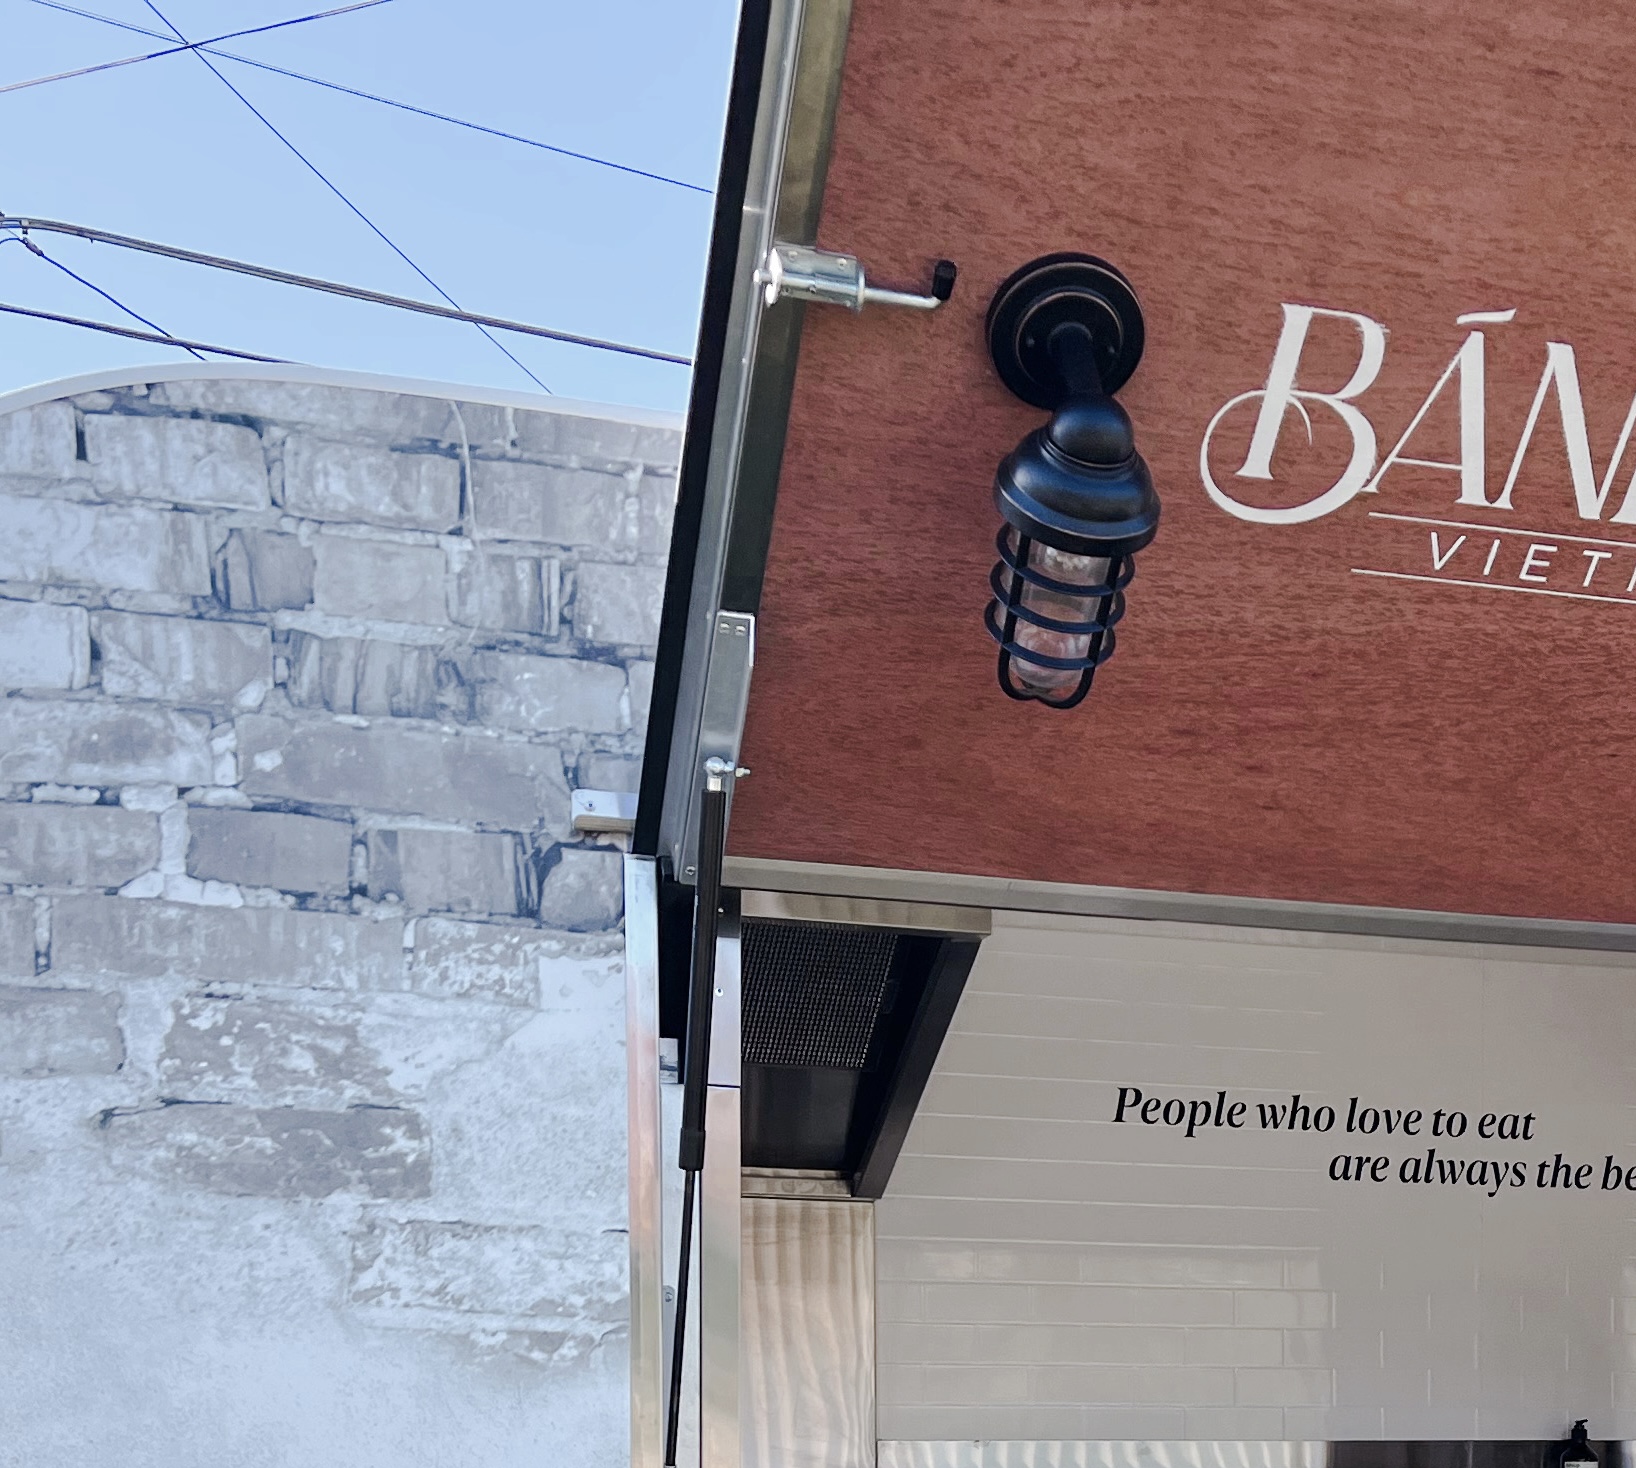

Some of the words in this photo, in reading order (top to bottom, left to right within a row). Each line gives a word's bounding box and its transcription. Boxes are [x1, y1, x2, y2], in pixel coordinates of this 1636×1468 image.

[1111, 1087, 1247, 1139] People
[1255, 1094, 1336, 1133] who
[1346, 1096, 1423, 1136] love
[1431, 1108, 1468, 1138] to
[1477, 1112, 1536, 1141] eat
[1328, 1154, 1390, 1183] are
[1398, 1148, 1527, 1198] always
[1536, 1153, 1593, 1190] the
